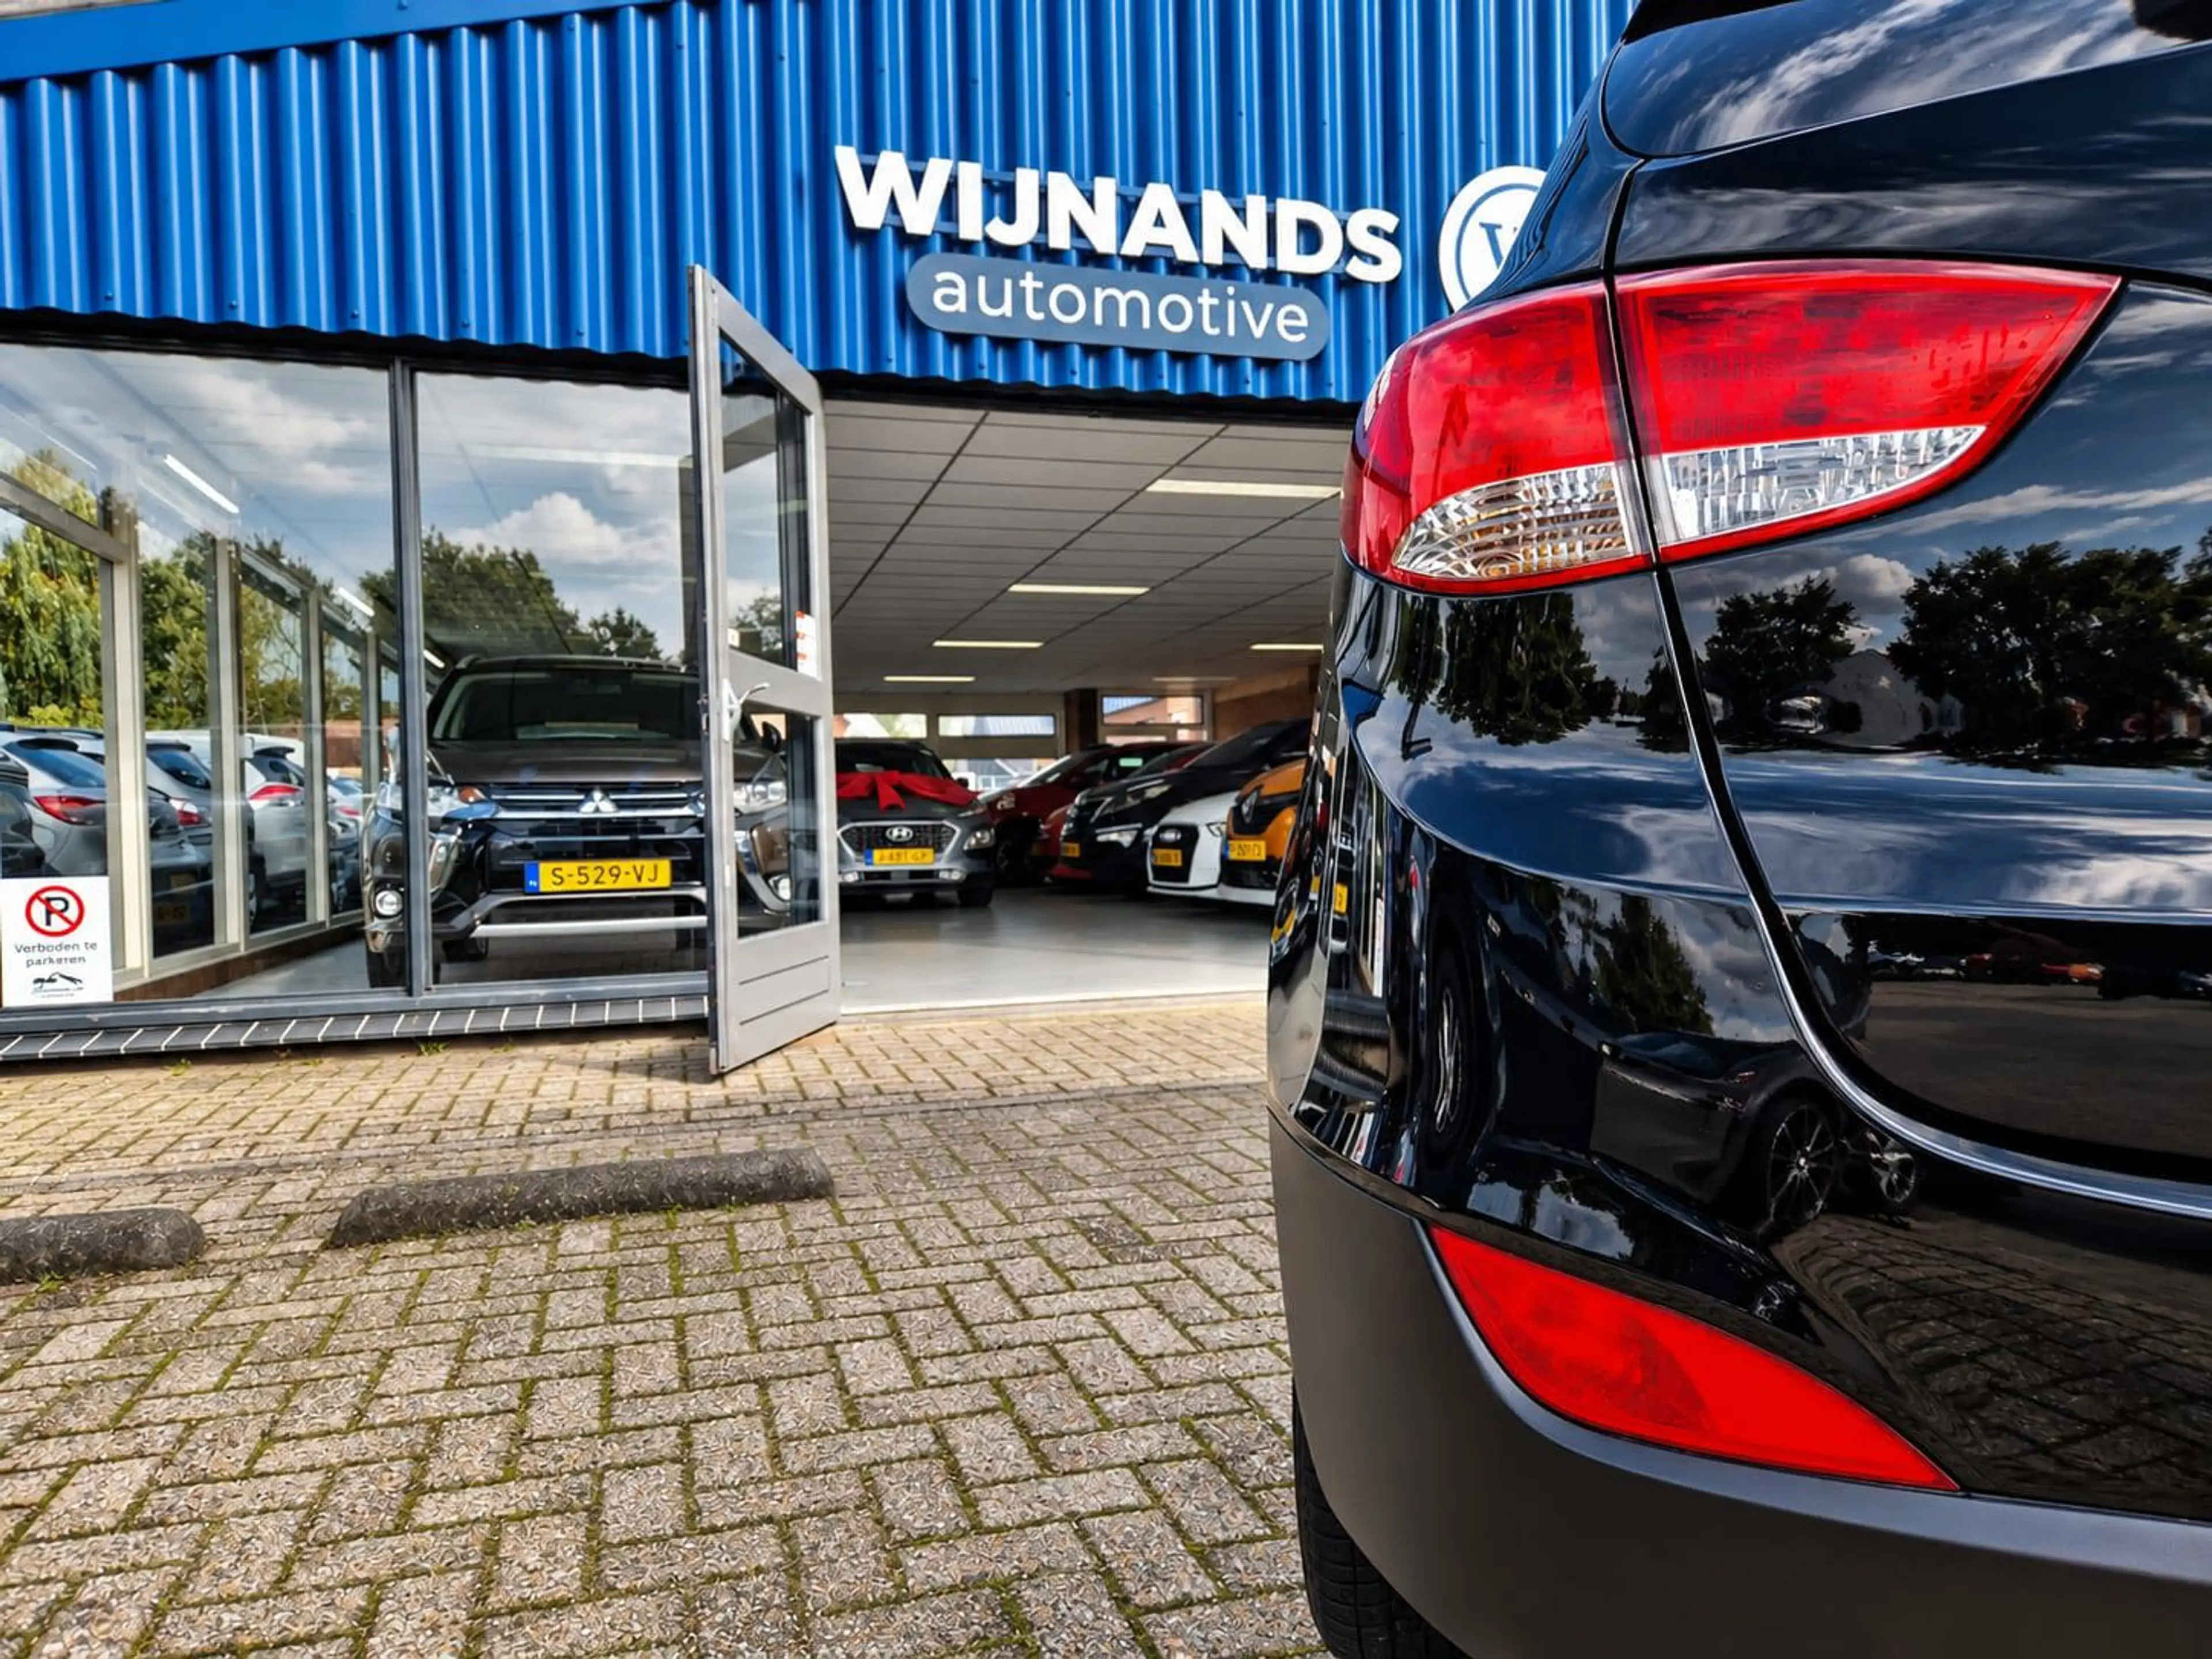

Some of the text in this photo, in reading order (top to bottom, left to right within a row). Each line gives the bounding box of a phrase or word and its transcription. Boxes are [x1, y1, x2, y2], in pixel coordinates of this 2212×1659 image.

[835, 145, 1403, 283] WIJNANDS
[933, 271, 1309, 343] automotive
[551, 864, 658, 886] S-529-VJ
[14, 941, 97, 953] Verboden te
